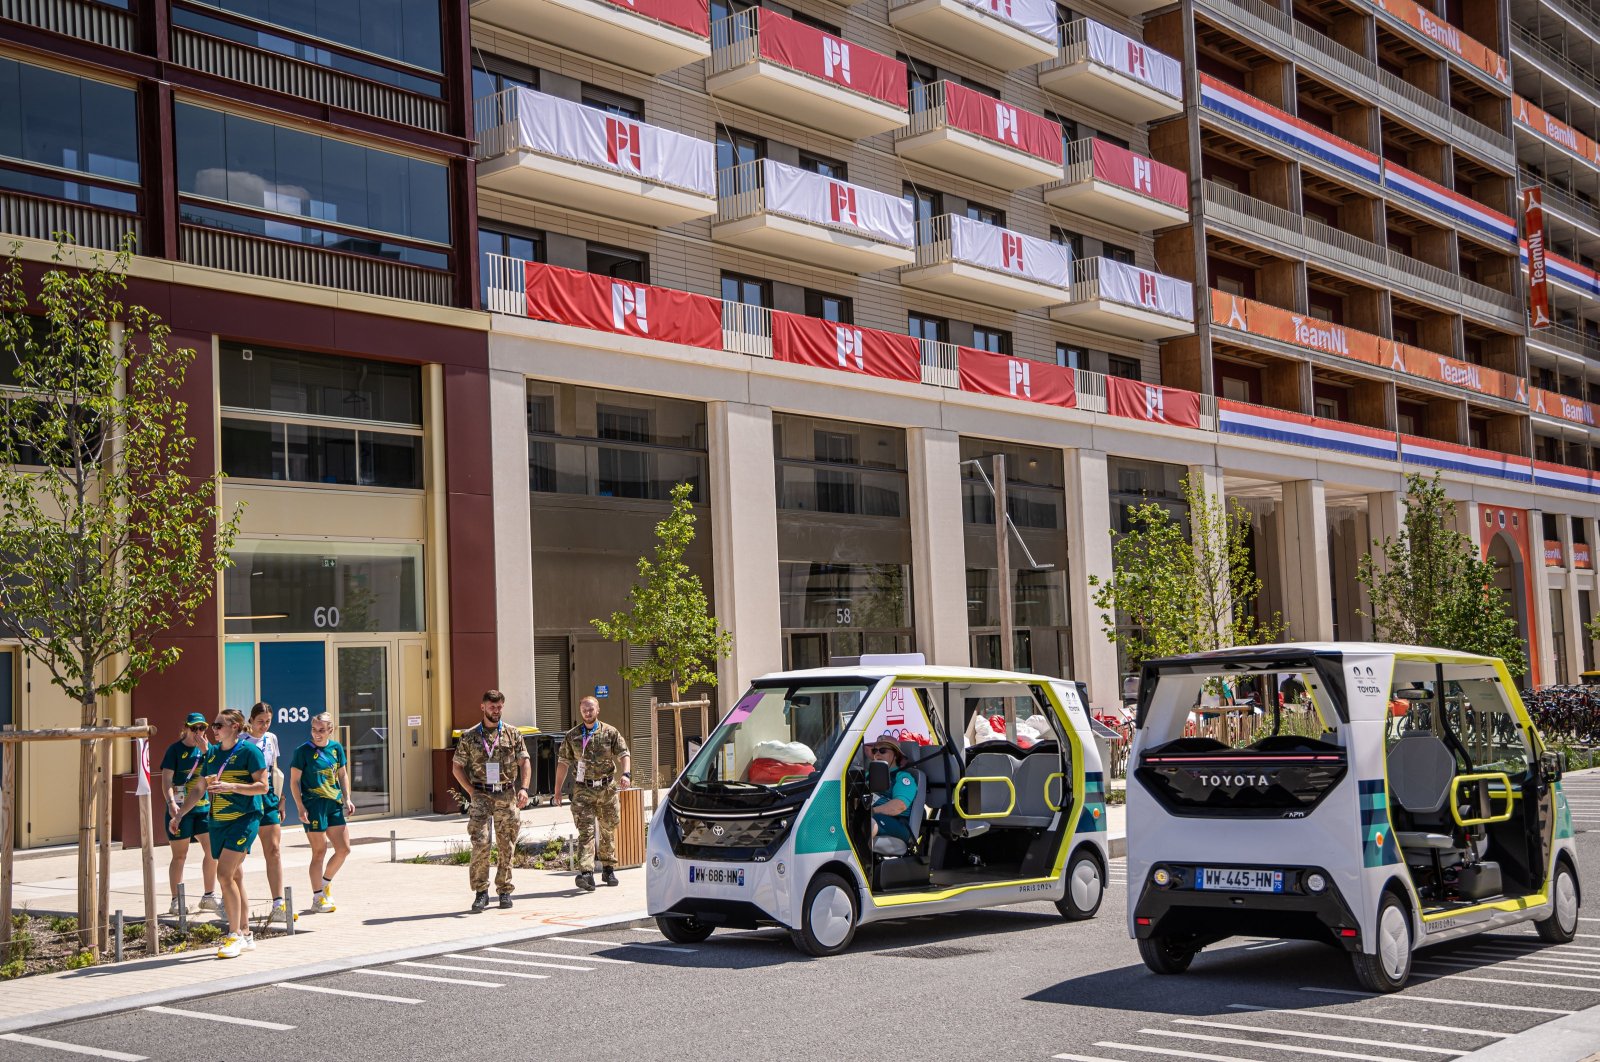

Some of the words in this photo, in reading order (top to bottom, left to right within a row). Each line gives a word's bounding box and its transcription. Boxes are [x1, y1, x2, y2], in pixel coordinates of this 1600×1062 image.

[1417, 8, 1462, 55] TeamNL
[1544, 114, 1578, 150] TeamNL
[1529, 230, 1545, 287] TeamNL
[1291, 317, 1349, 355] TeamNL
[1438, 358, 1481, 389] TeamNL
[1561, 398, 1594, 424] TeamNL
[1544, 549, 1561, 559] eamNL
[314, 606, 340, 627] 60
[836, 608, 851, 623] 58
[278, 707, 309, 723] A33
[1200, 775, 1269, 786] TOYOTA
[695, 868, 738, 884] WW-686-HN
[1205, 870, 1272, 887] WW-445-HN
[1037, 883, 1052, 891] 2024
[1274, 881, 1282, 889] 75
